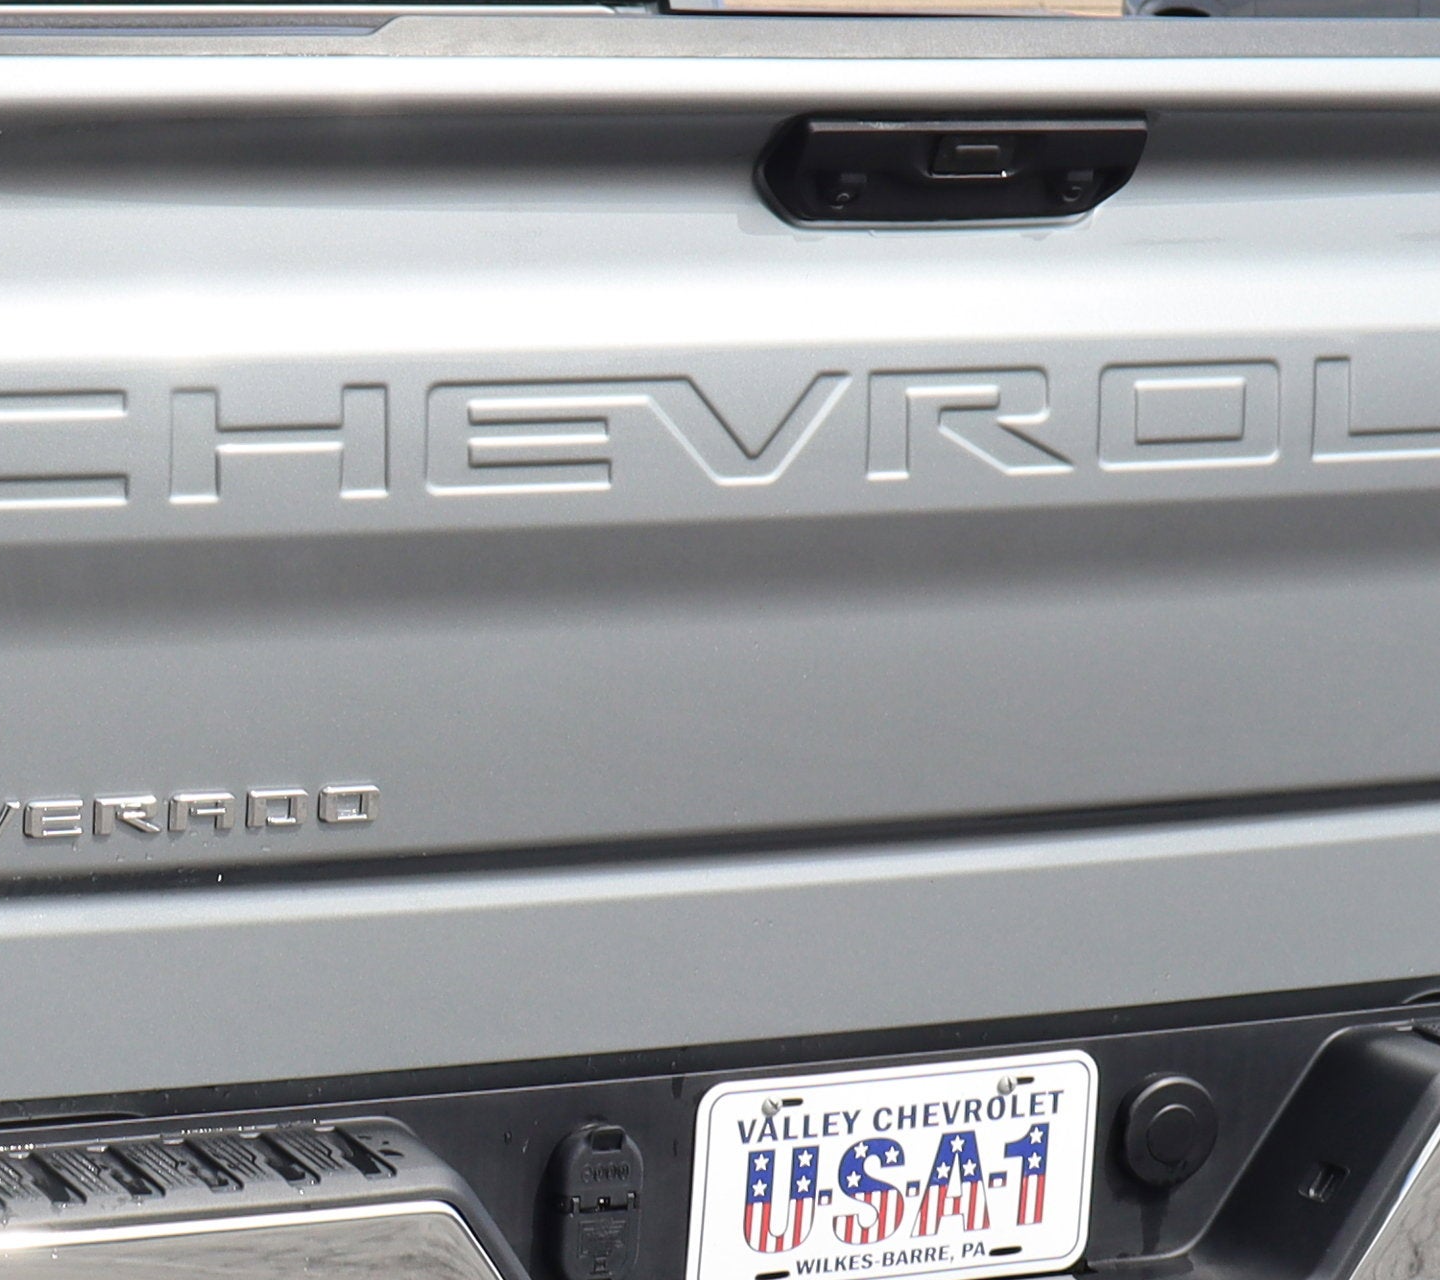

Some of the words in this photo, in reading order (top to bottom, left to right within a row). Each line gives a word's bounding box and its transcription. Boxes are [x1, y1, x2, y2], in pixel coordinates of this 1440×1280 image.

[737, 1110, 861, 1144] VALLEY
[872, 1090, 1065, 1133] CHEVROLET
[796, 1245, 954, 1276] WILKES-BARRE,
[961, 1241, 987, 1259] PA
